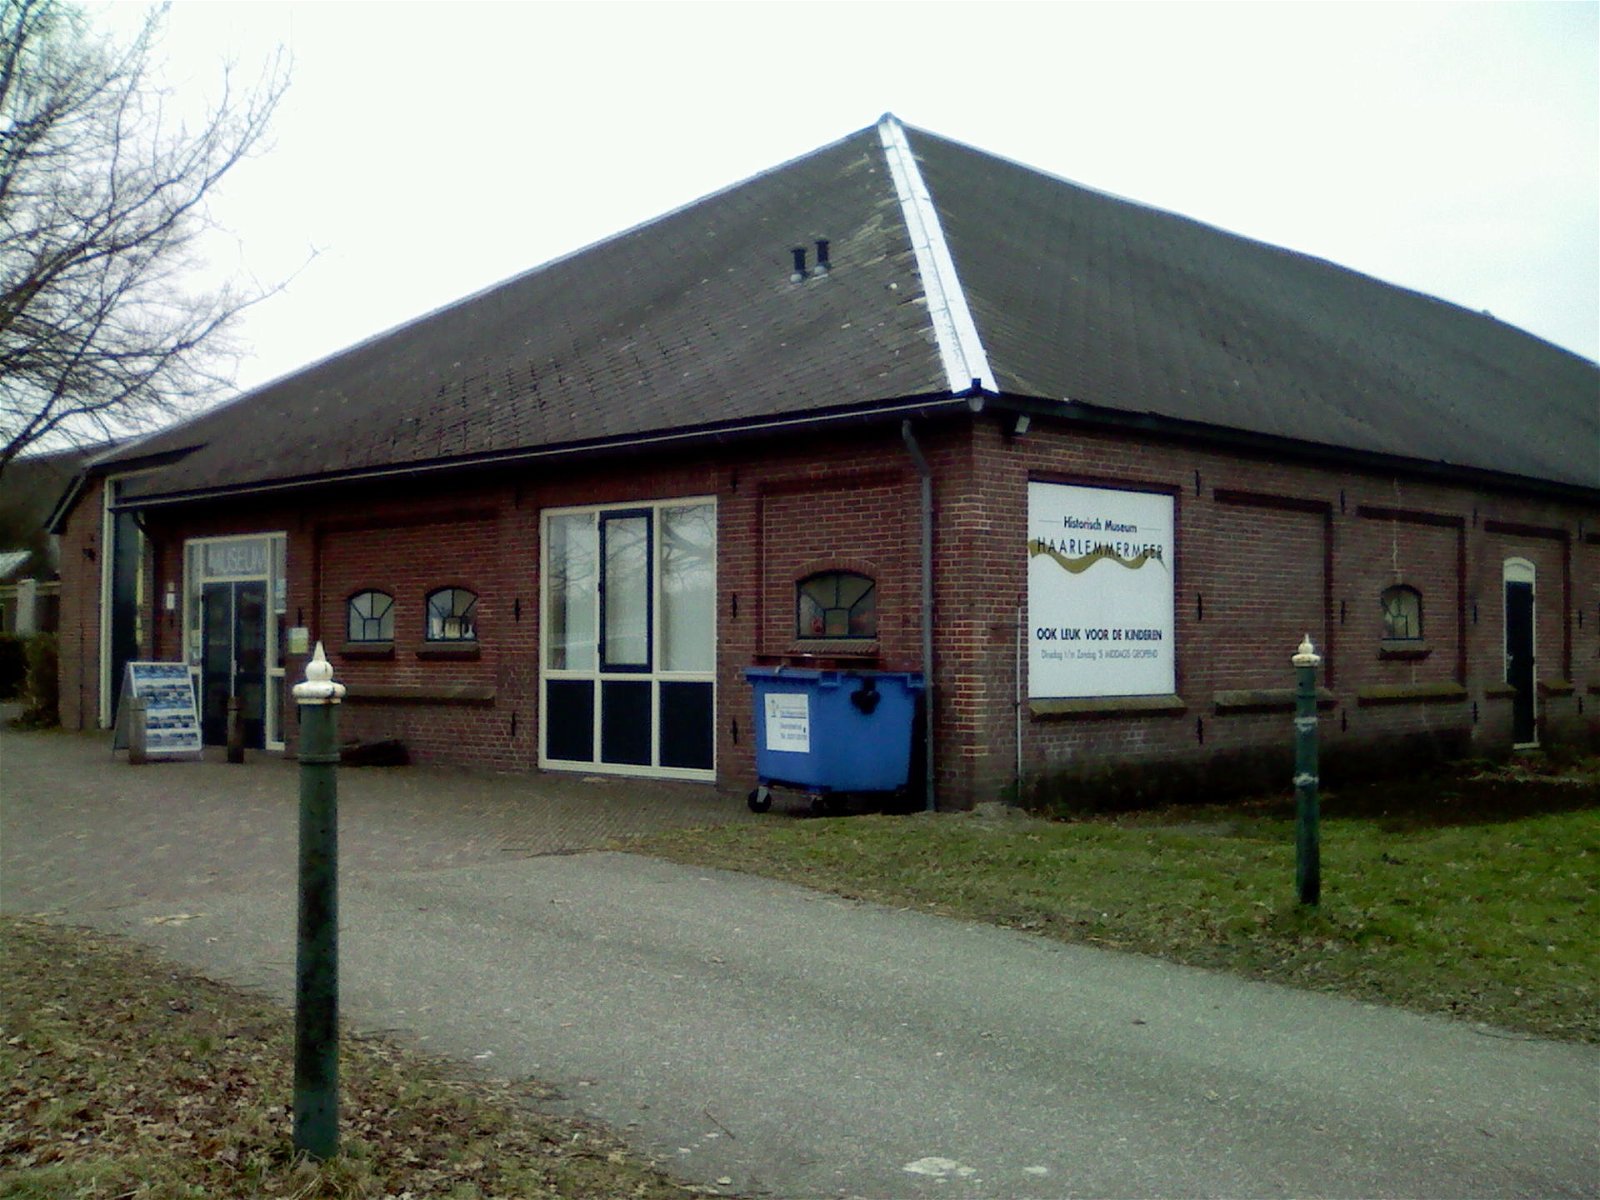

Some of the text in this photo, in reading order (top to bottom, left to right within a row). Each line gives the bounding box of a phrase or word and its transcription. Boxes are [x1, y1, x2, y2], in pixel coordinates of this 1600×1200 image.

[1064, 516, 1137, 533] Historisch Museum
[1037, 536, 1163, 559] HAARLEMMERMEER
[1037, 628, 1162, 640] OOK LEUK VOOR DE KINDEREN
